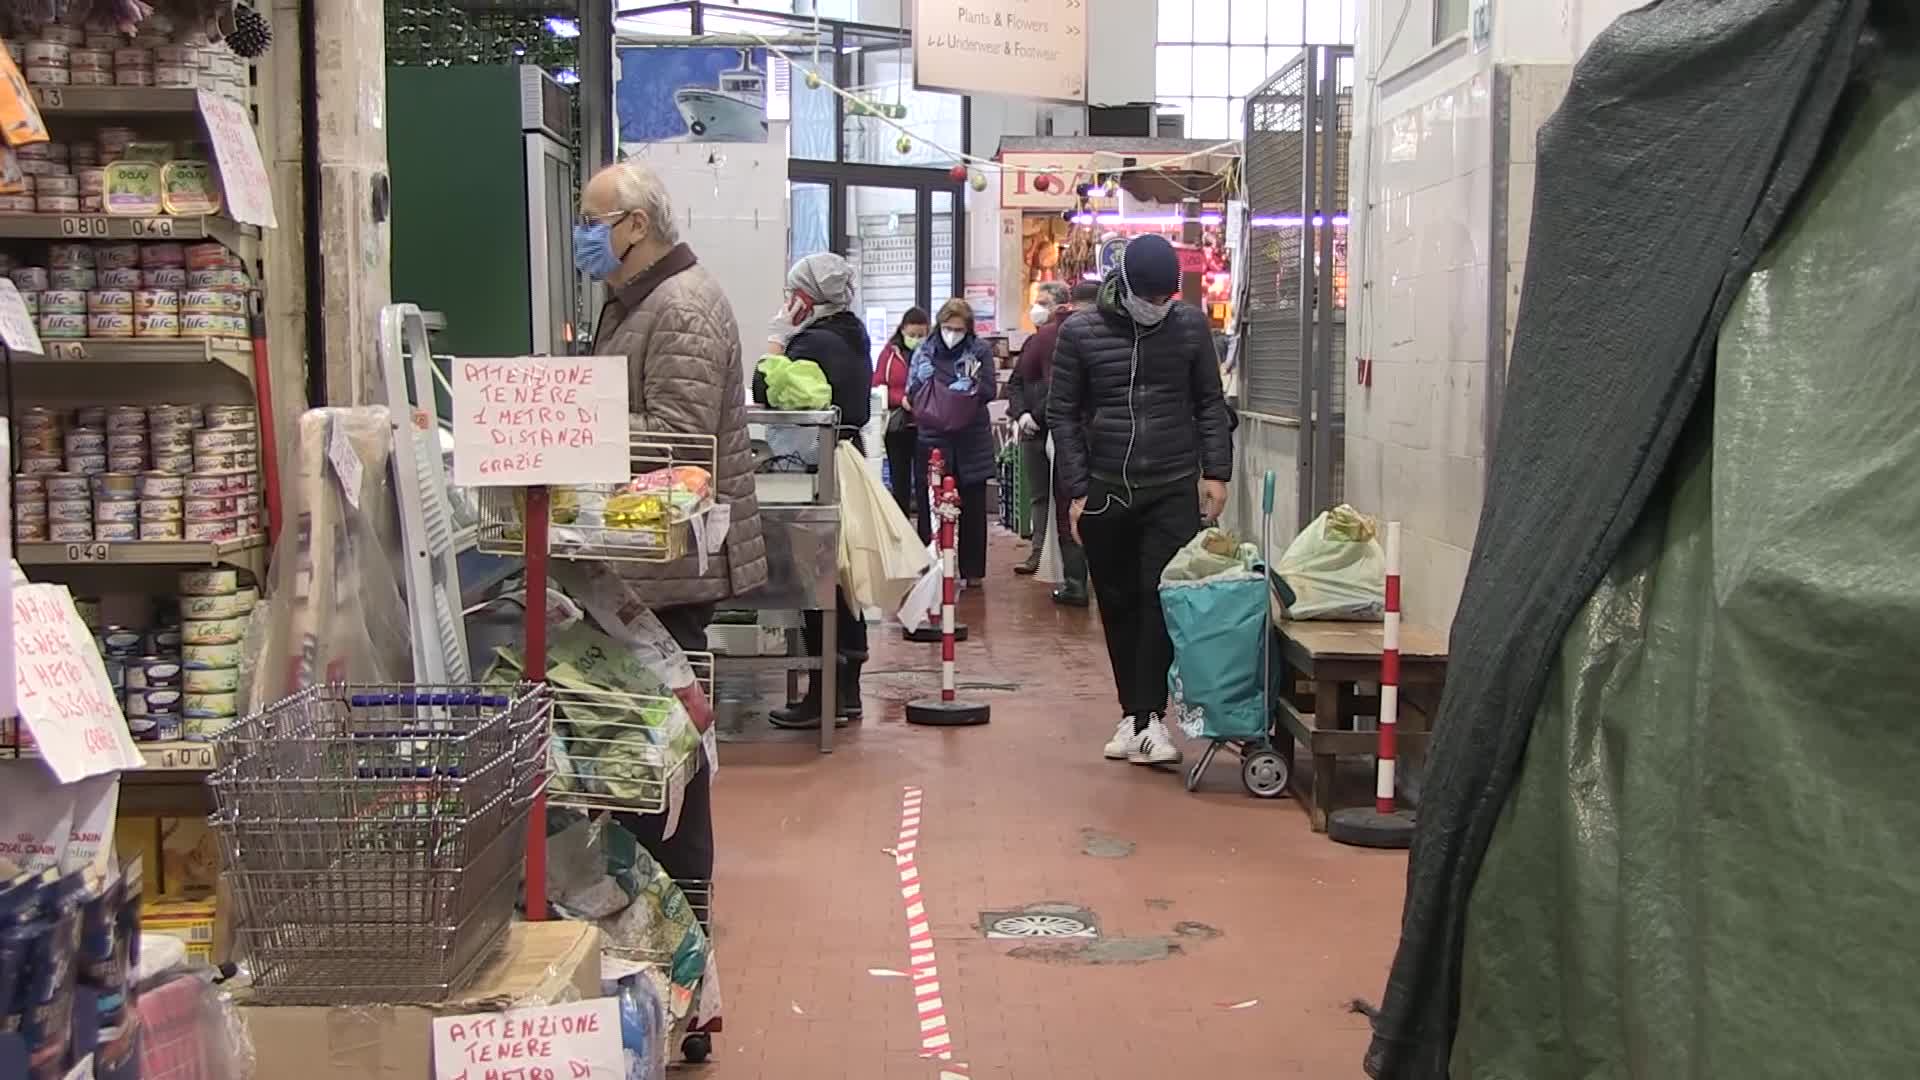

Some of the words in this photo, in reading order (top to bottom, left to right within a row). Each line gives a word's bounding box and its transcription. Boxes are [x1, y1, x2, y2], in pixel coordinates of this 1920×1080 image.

[958, 8, 990, 25] Plants
[993, 13, 1003, 27] &
[1007, 14, 1049, 33] Flowers
[947, 33, 1001, 55] Underwear
[1004, 42, 1011, 55] &
[1014, 42, 1059, 60] Footwear
[63, 217, 106, 234] 080
[480, 384, 577, 404] TENERE
[473, 406, 487, 424] 1
[499, 407, 566, 425] METRO
[68, 544, 106, 560] 049
[464, 1038, 552, 1064] TENERE
